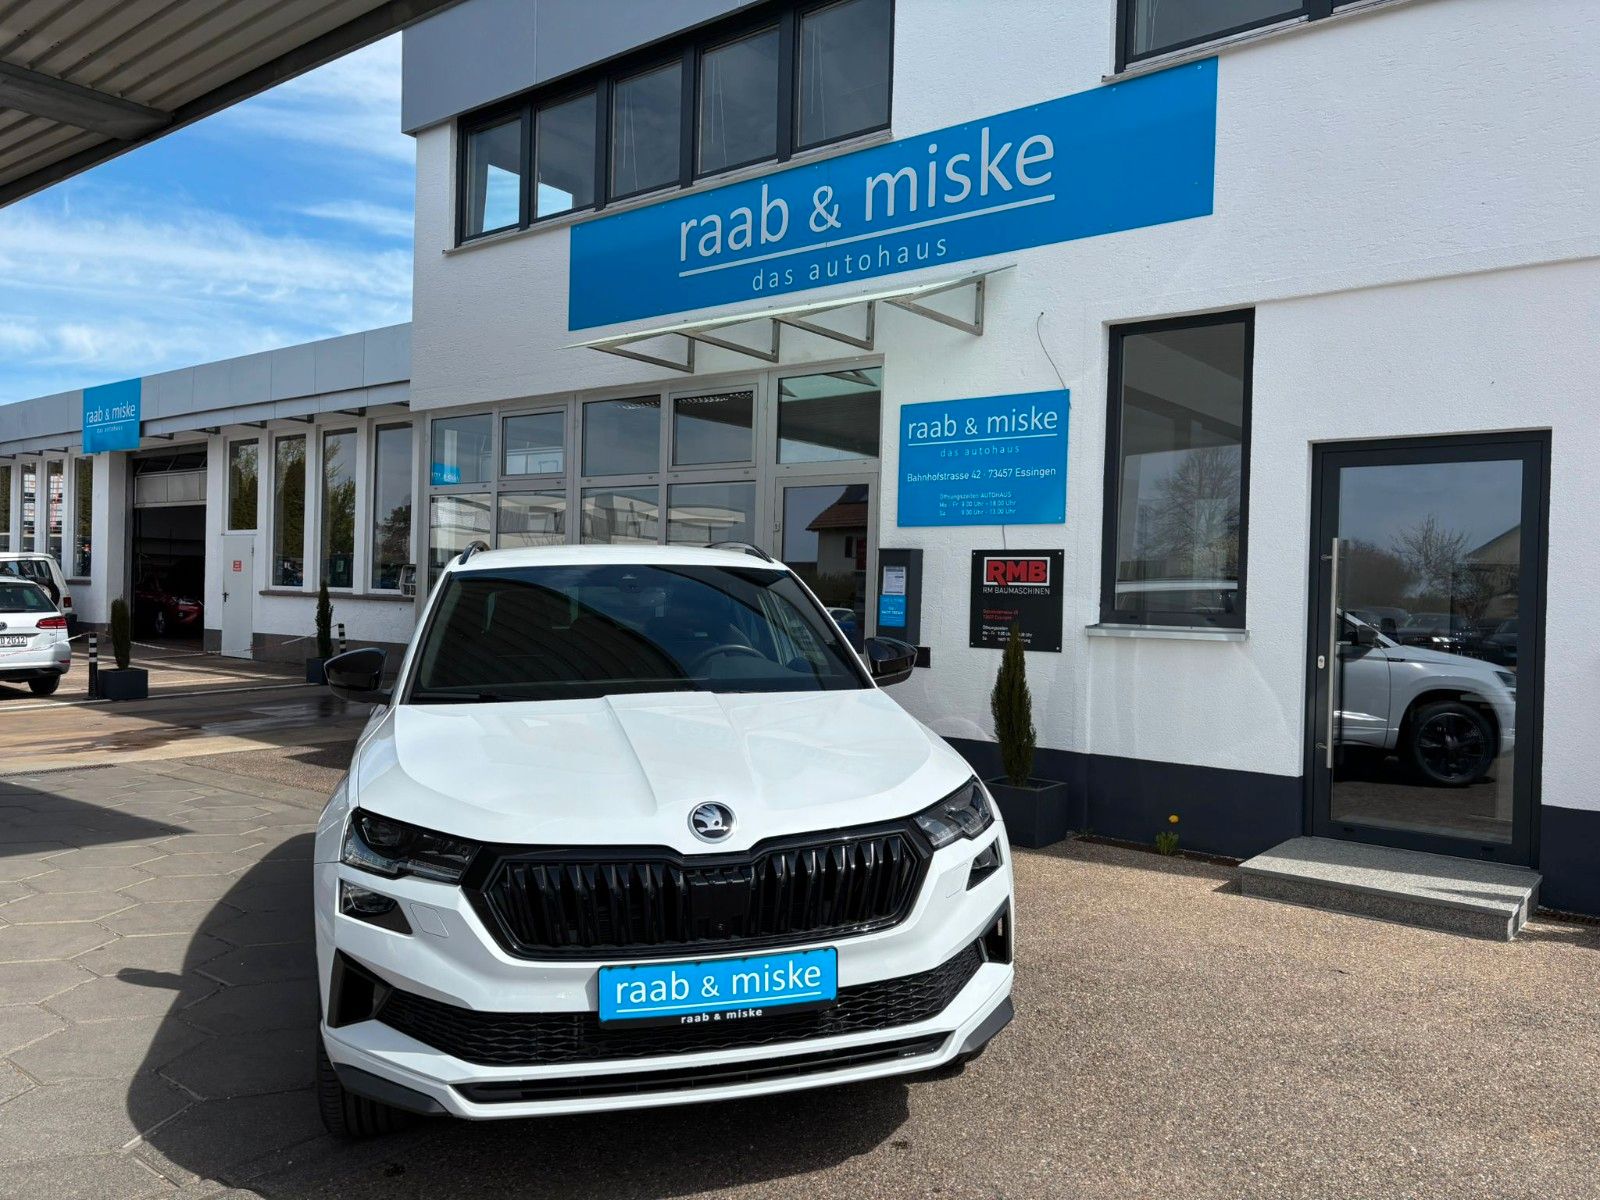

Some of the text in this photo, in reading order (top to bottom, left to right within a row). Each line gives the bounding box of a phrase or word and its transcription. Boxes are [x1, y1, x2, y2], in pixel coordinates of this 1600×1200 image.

[680, 126, 1055, 262] raab & miske
[752, 238, 947, 291] das autohaus
[86, 400, 136, 424] raab & miske
[908, 405, 1058, 440] raab & miske
[940, 445, 1020, 457] das autohaus
[907, 472, 969, 483] Bahnhofstrasse
[971, 469, 981, 479] 42
[988, 468, 1013, 479] 73457
[1015, 467, 1056, 479] Essingen
[986, 560, 1048, 586] RMB
[994, 586, 1050, 595] BAUMASCHINEN
[616, 960, 822, 1004] raab & miske
[680, 1008, 763, 1024] raab & miske
